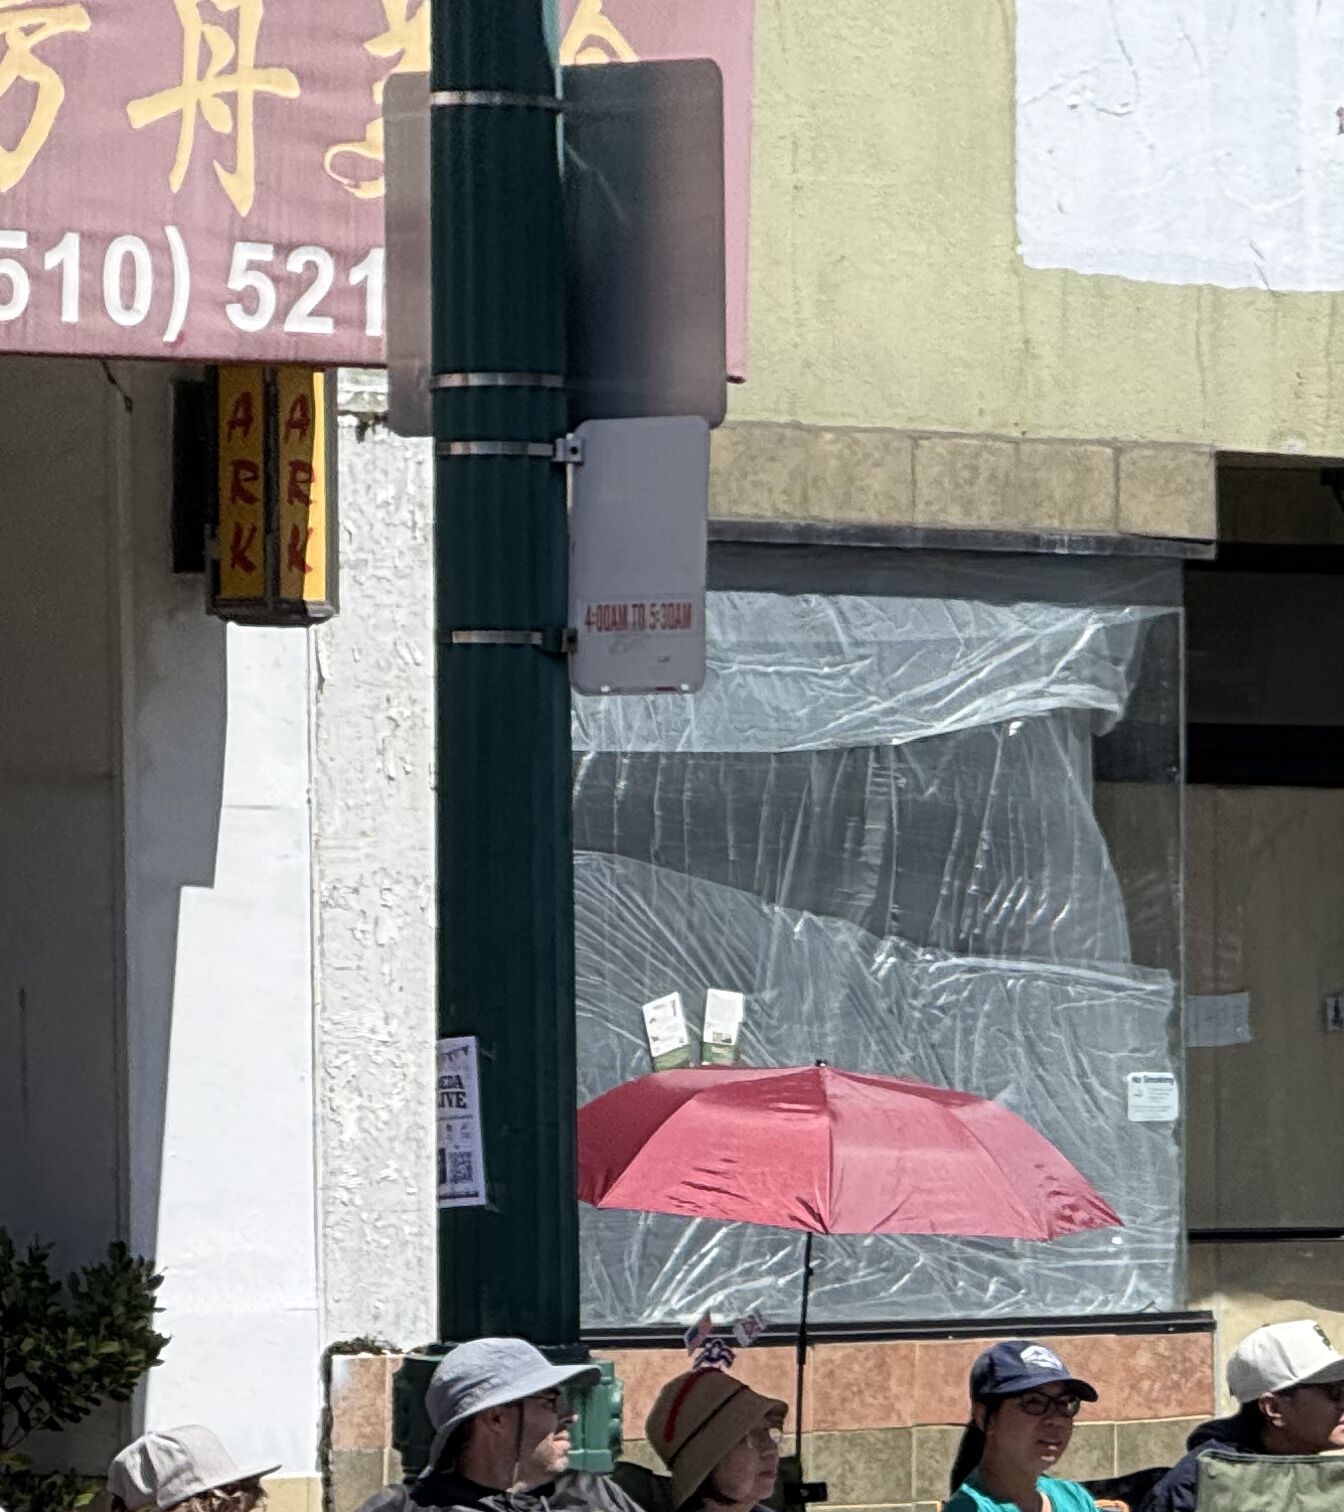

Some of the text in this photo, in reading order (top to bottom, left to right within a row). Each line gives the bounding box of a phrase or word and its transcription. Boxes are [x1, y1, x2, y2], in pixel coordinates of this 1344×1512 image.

[226, 391, 260, 573] ARK
[283, 393, 315, 574] ARK
[631, 602, 646, 631] TO
